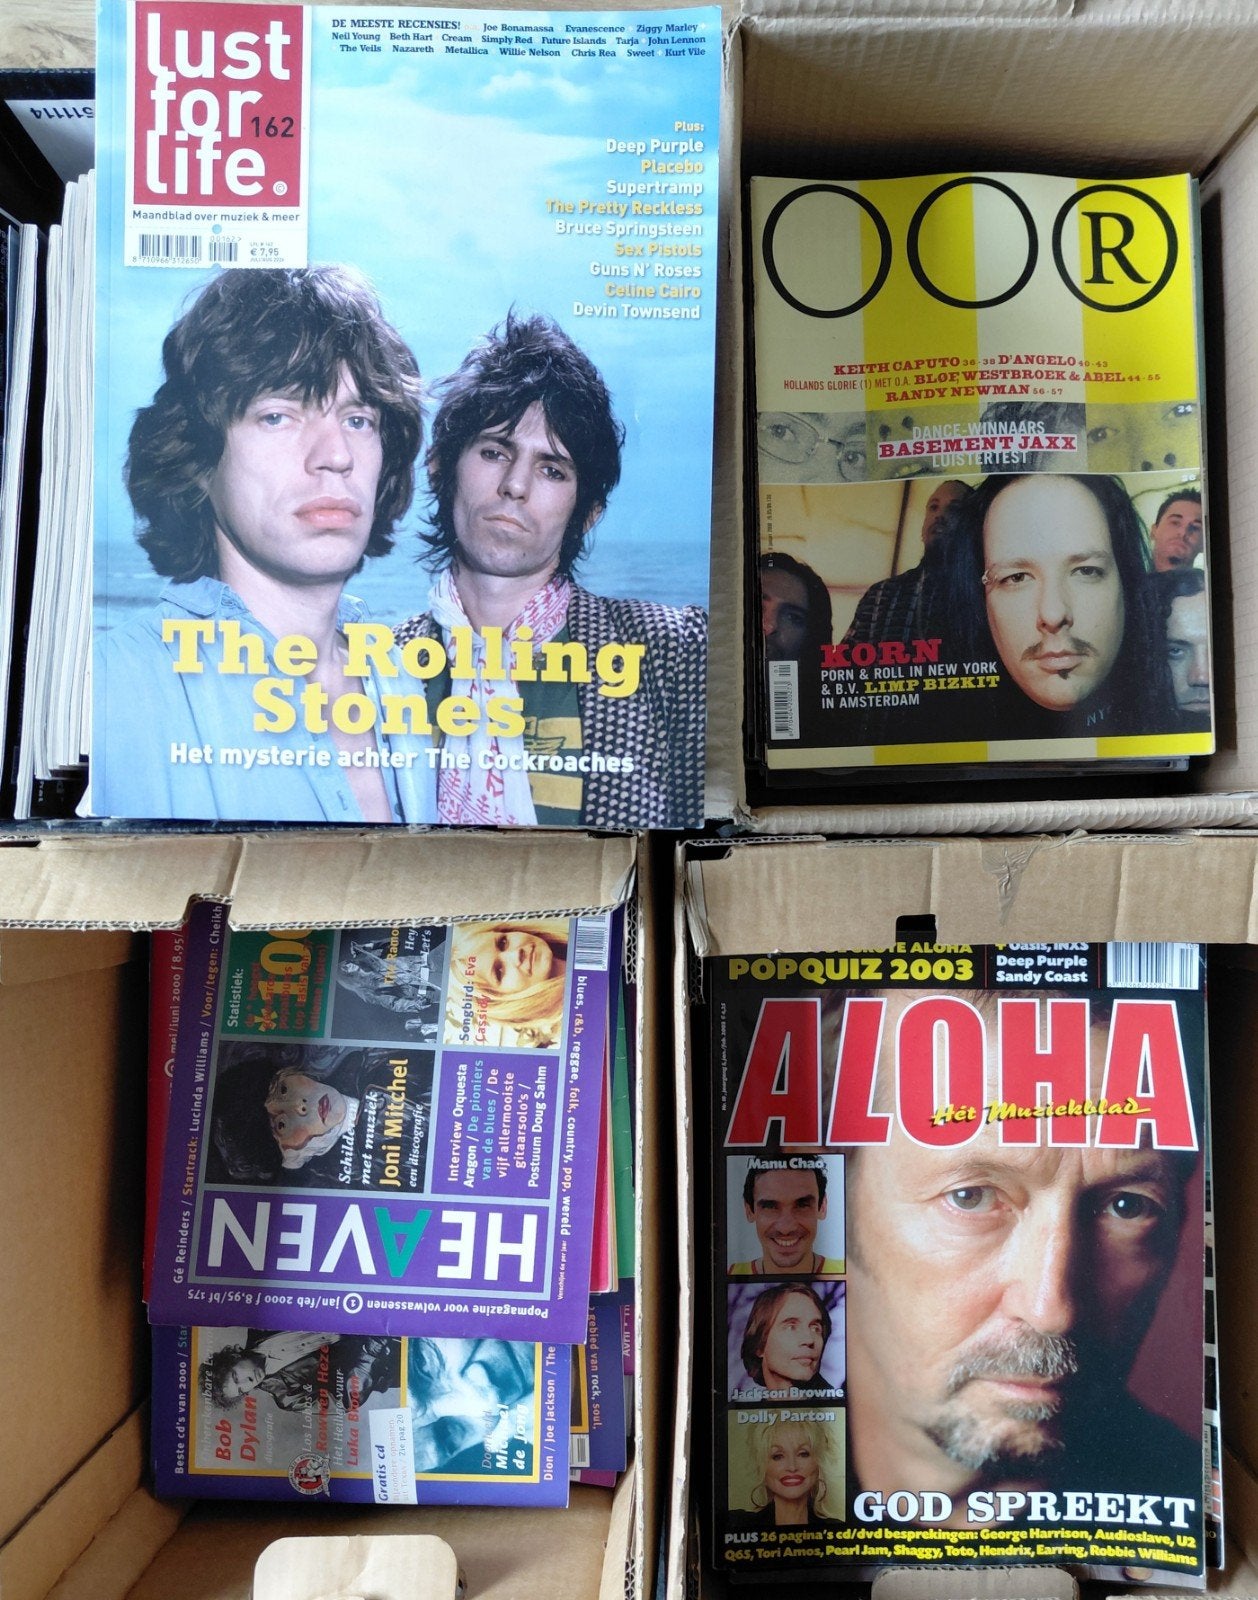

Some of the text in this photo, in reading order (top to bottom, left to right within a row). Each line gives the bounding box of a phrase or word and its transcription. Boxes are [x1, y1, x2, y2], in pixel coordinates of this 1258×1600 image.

[350, 19, 394, 28] MEESTE
[398, 20, 461, 30] RECENSIES!
[501, 24, 554, 32] Bonamassa
[566, 25, 625, 33] Evanescence
[147, 13, 291, 80] lust
[392, 45, 489, 54] Nazareth Metallica
[251, 116, 294, 138] 162
[674, 121, 704, 132] Plus:
[606, 138, 704, 155] Deep Purple
[641, 159, 704, 174] Placebo
[606, 180, 703, 196] Supertramp
[132, 210, 300, 222] Maandblad over muziek meer
[546, 199, 703, 218] The Pretty Reckless
[555, 219, 702, 238] Bruce Springsteen
[614, 242, 702, 256] Sex Pistols
[590, 261, 702, 277] Guns Roses
[605, 282, 701, 298] Celine Cairo
[572, 302, 700, 319] Devin Townsend
[833, 354, 1077, 376] KEITH CAPUTO D'ANGELO
[784, 369, 1126, 391] HOLLANDS GLORIE WESTBROEK ABEL
[885, 384, 1031, 403] RANDY NEWMAN
[912, 420, 1046, 440] DANCE-WINNAARS
[878, 436, 1077, 458] BASEMENT JAXX
[932, 450, 1028, 468] LUISTERTEST
[162, 618, 646, 698] The Rolling
[820, 638, 942, 668] KORN
[820, 661, 998, 682] PORN ROLL NEW YORK
[835, 675, 1000, 695] B.V. LIMP BIZKIT
[252, 677, 526, 738] Stones
[839, 694, 920, 708] AMSTERDAM
[170, 742, 635, 774] Het mysterie achter The Cockroaches
[910, 942, 973, 954] ALOHA
[996, 955, 1088, 969] Deep Purple
[728, 957, 974, 985] POPQUIZ 2003
[996, 970, 1088, 985] Sandy Coast
[227, 968, 244, 1028] Statistiek:
[460, 956, 476, 1042] Songbird: Eva
[574, 976, 588, 1010] blues,
[476, 994, 492, 1043] Cassidy
[569, 1041, 580, 1084] reggae,
[723, 994, 1199, 1151] ALOHA
[175, 905, 222, 1262] Reinders Startrack: Lucinda Williams Cheikh
[379, 1058, 408, 1187] Joni Mitchel
[448, 1064, 468, 1182] Interview Orquesta
[463, 1060, 484, 1188] Aragon De pioniers
[482, 1068, 499, 1180] van blues De
[496, 1072, 514, 1178] vijf allermooiste
[982, 1096, 1152, 1126] Muziekblad
[362, 1091, 379, 1185] met muziek
[408, 1104, 425, 1166] discografie
[513, 1093, 529, 1169] gitaarsolo's
[528, 1065, 547, 1188] Postuum Doug Sahm
[563, 1116, 576, 1164] country,
[338, 1100, 358, 1184] Schilderen
[748, 1157, 826, 1170] Manu Chao
[560, 1195, 572, 1236] wereld
[207, 1198, 538, 1283] HEAVEN
[264, 1294, 549, 1319] Popmagazine voor volwassenen jan/feb 2000
[317, 1344, 330, 1383] Heze
[731, 1387, 844, 1402] Jackson Browne
[174, 1362, 188, 1474] Beste 2000
[544, 1346, 556, 1482] Dion Joe Jackson The
[738, 1408, 836, 1426] Dolly Parton
[214, 1418, 232, 1461] Bob
[240, 1396, 260, 1462] Dylan
[346, 1428, 359, 1466] Luka
[514, 1449, 526, 1470] de
[374, 1444, 388, 1502] Gratis cd
[854, 1490, 1196, 1528] GOD SPREEKT
[724, 1528, 1196, 1548] PLUS pagina's cd/dvd besprekingen: George Harrison, Audioslave, U2
[756, 1544, 1198, 1566] Tori Amos, Pearl Jam, Shaggy, Toto, Hendrix, Earring, Robbie Williams
